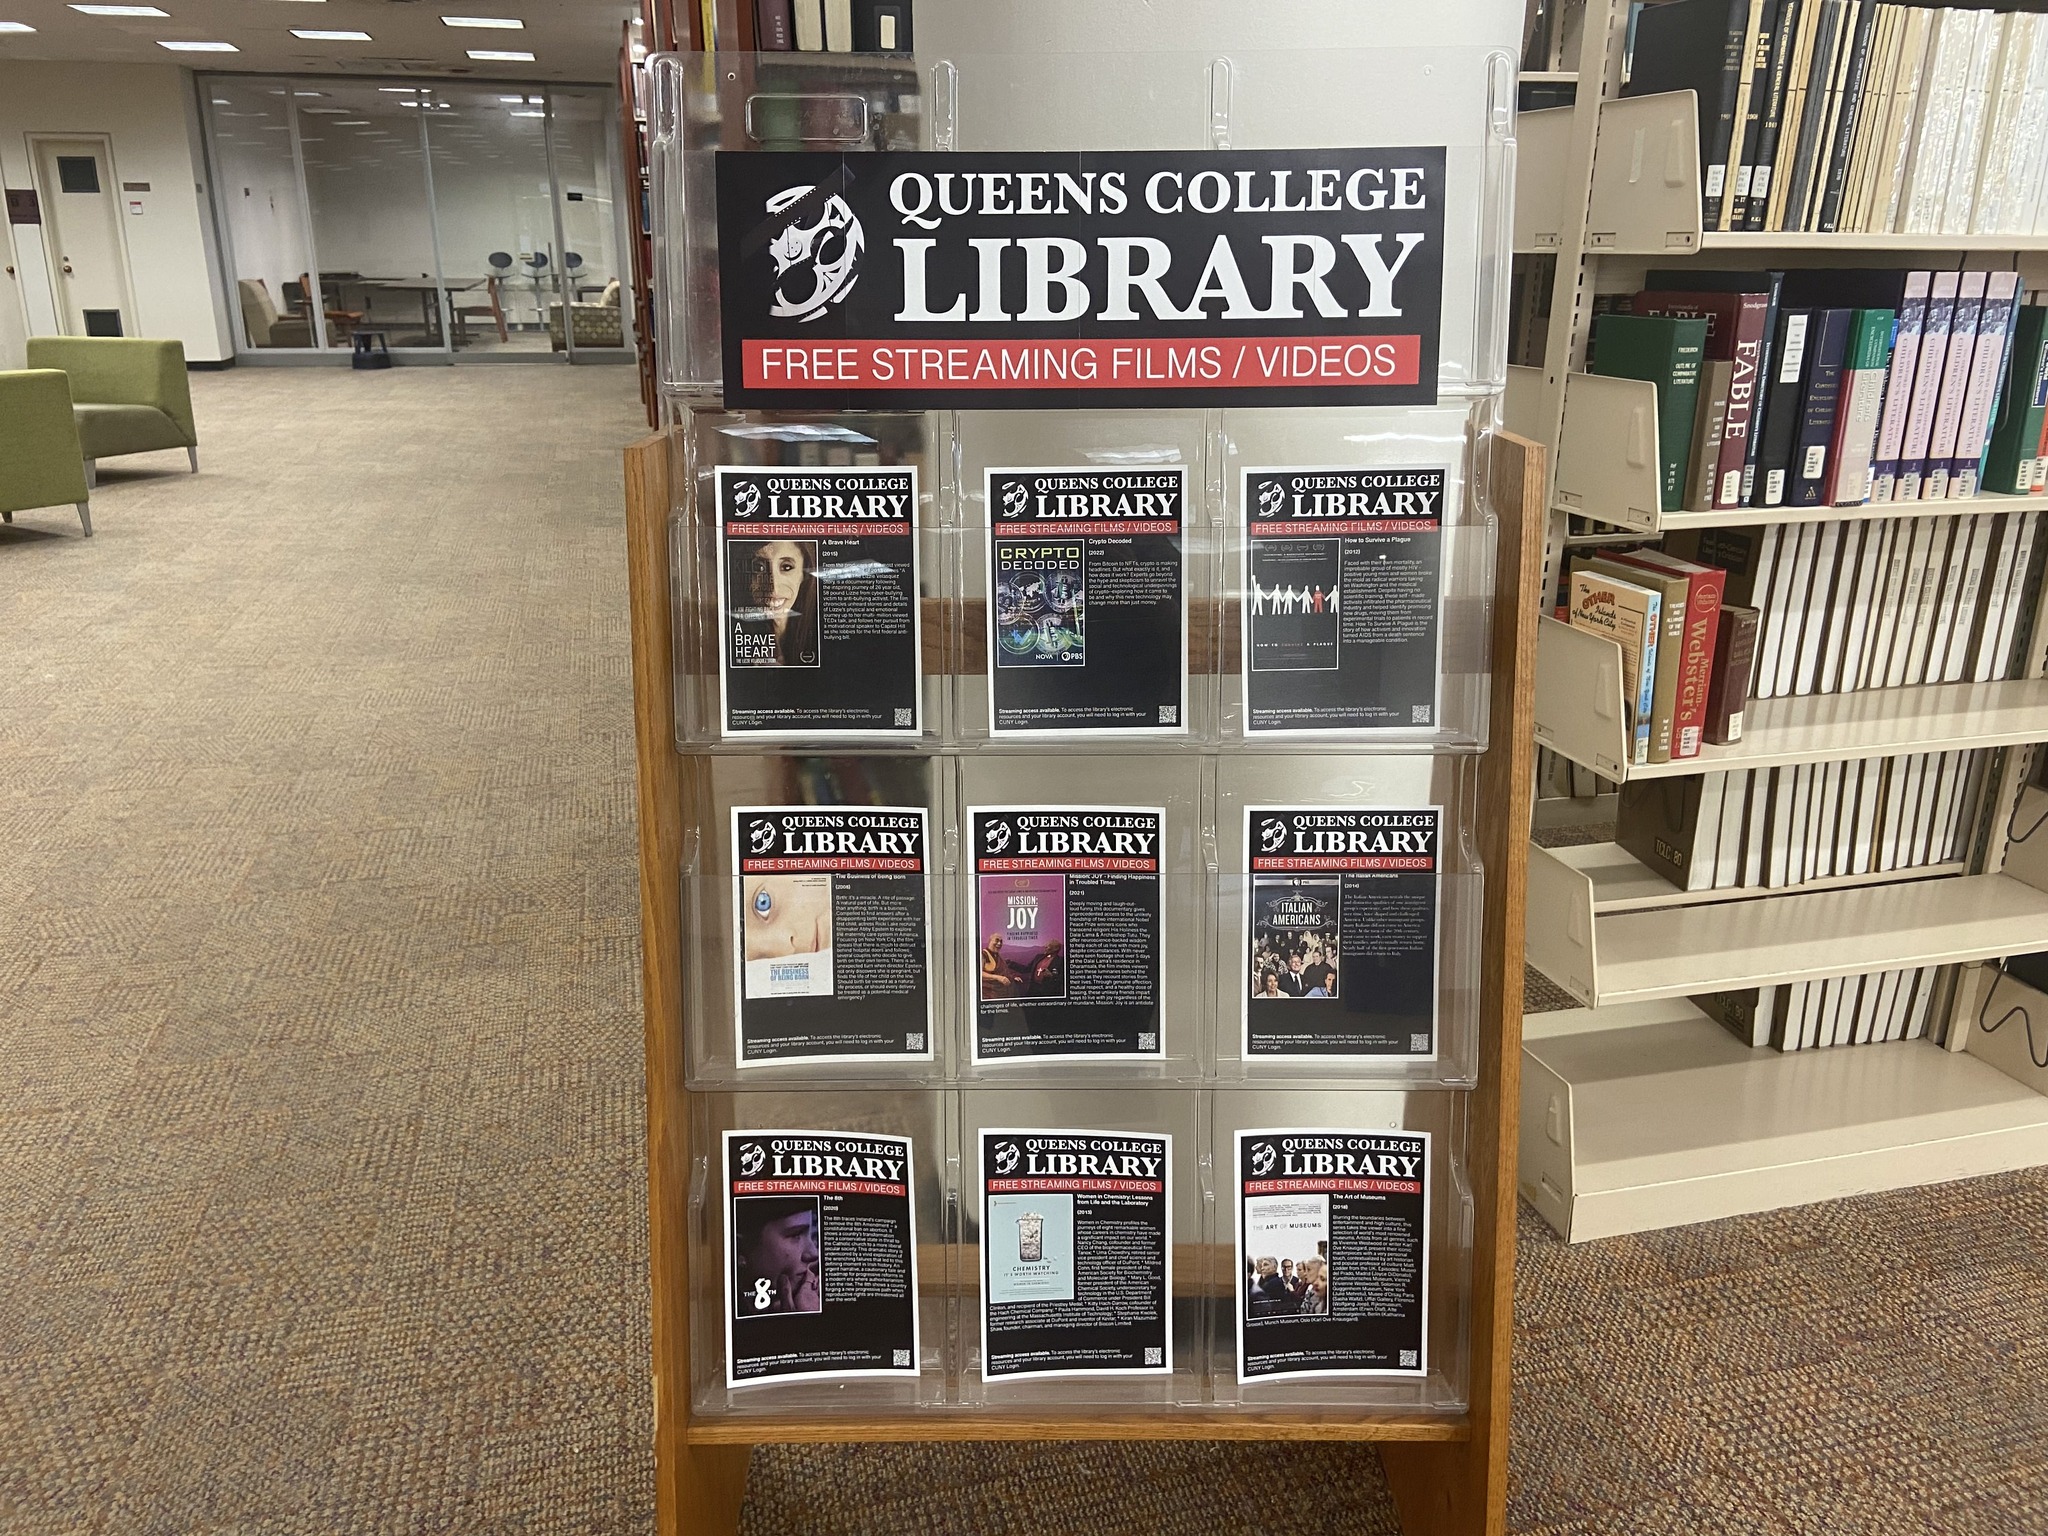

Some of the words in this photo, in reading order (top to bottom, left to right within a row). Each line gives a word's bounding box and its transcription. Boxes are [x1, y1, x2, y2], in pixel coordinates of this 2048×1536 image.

[889, 172, 1132, 229] QUEENS
[1146, 168, 1426, 212] COLLEGE
[893, 233, 1425, 322] LIBRARY
[762, 349, 861, 382] FREE
[871, 348, 1099, 380] STREAMING
[1110, 346, 1222, 379] FILMS
[1257, 345, 1396, 377] VIDEOS
[1725, 339, 1757, 439] FABLE
[1884, 398, 1898, 455] LITERATURE
[1910, 399, 1926, 456] LITERATURE
[767, 478, 832, 494] QUEENS
[836, 478, 909, 490] COLLEGE
[1034, 478, 1098, 494] QUEENS
[1102, 476, 1178, 489] COLLEGE
[1291, 476, 1357, 491] QUEENS
[1361, 474, 1440, 488] COLLEGE
[768, 494, 909, 518] LIBRARY
[1036, 493, 1178, 518] LIBRARY
[1292, 491, 1439, 517] LIBRARY
[732, 524, 759, 533] FREE
[762, 524, 825, 534] STREAMING
[827, 524, 858, 533] FILMS
[867, 524, 903, 533] VIDEOS
[1000, 524, 1027, 534] FREE
[1029, 523, 1092, 534] STREAMING
[1094, 523, 1125, 533] FILMS
[1134, 522, 1172, 532] VIDEOS
[1255, 523, 1283, 533] FREE
[1285, 522, 1348, 533] STREAMING
[1350, 522, 1383, 533] FILMS
[1390, 521, 1431, 532] VIDEOS
[1000, 547, 1079, 560] CRYPTO
[1001, 560, 1080, 570] DECODED
[1580, 584, 1590, 594] The
[1582, 591, 1615, 610] OTHER
[1578, 608, 1589, 620] New
[1589, 613, 1603, 625] York
[1604, 617, 1616, 631] City
[1595, 605, 1617, 619] Islands
[734, 622, 743, 634] A
[1648, 614, 1658, 648] OTHER
[735, 635, 776, 646] BRAVE
[735, 647, 776, 658] HEART
[1071, 652, 1083, 660] PBS
[1680, 618, 1708, 721] Webster's
[782, 816, 844, 831] QUEENS
[847, 817, 919, 829] COLLEGE
[1017, 816, 1079, 831] QUEENS
[1082, 817, 1156, 829] COLLEGE
[1293, 815, 1356, 829] QUEENS
[1359, 815, 1434, 827] COLLEGE
[783, 832, 919, 854] LIBRARY
[1017, 832, 1155, 854] LIBRARY
[1293, 831, 1433, 853] LIBRARY
[1656, 839, 1671, 860] TCLC
[1673, 850, 1682, 866] 80
[748, 860, 775, 869] FREE
[777, 859, 838, 869] STREAMING
[841, 859, 870, 868] FILMS
[879, 859, 915, 869] VIDEOS
[983, 860, 1009, 869] FREE
[1011, 859, 1072, 868] STREAMING
[1075, 859, 1104, 868] FILMS
[1112, 859, 1150, 869] VIDEOS
[1258, 859, 1284, 868] FREE
[1286, 858, 1348, 868] STREAMING
[1350, 858, 1381, 867] FILMS
[1389, 858, 1426, 867] VIDEOS
[1007, 896, 1038, 906] MISSION:
[1281, 902, 1312, 913] ITALIAN
[1007, 908, 1038, 929] JOY
[1272, 914, 1321, 926] AMERICANS
[771, 1140, 832, 1154] QUEENS
[834, 1141, 904, 1157] COLLEGE
[1026, 1139, 1087, 1153] QUEENS
[1090, 1141, 1162, 1154] COLLEGE
[1282, 1138, 1344, 1153] QUEENS
[1347, 1140, 1421, 1153] COLLEGE
[772, 1155, 905, 1181] LIBRARY
[1026, 1153, 1162, 1178] LIBRARY
[1283, 1154, 1421, 1178] LIBRARY
[738, 1182, 764, 1191] FREE
[766, 1181, 825, 1191] STREAMING
[828, 1182, 857, 1191] FILMS
[863, 1183, 900, 1194] VIDEOS
[992, 1180, 1018, 1189] FREE
[1020, 1180, 1080, 1189] STREAMING
[1082, 1180, 1111, 1189] FILMS
[1119, 1181, 1156, 1191] VIDEOS
[1249, 1181, 1275, 1191] FREE
[1276, 1180, 1336, 1190] STREAMING
[1338, 1180, 1368, 1190] FILMS
[1376, 1181, 1414, 1191] VIDEOS
